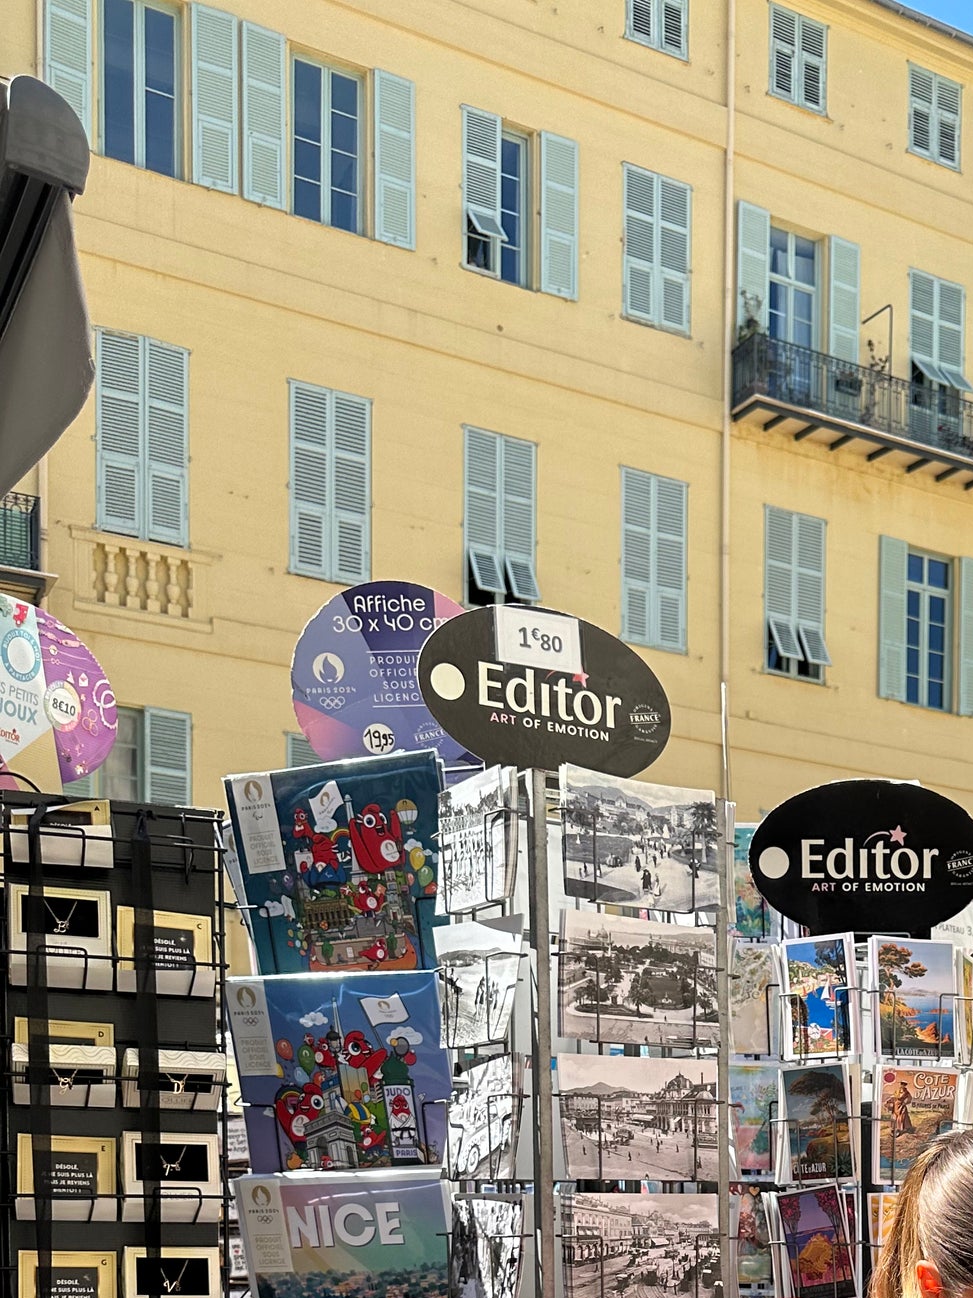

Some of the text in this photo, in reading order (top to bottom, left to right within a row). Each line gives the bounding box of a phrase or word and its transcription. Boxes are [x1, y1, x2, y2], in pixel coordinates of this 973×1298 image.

[354, 594, 426, 613] Affiche
[333, 615, 363, 633] 30
[368, 619, 380, 632] x
[383, 613, 414, 632] 40
[518, 627, 563, 653] 1€80
[306, 687, 331, 695] PARIS
[383, 680, 415, 689] SOUS
[9, 685, 39, 706] PETITS
[373, 693, 420, 703] LICENC
[477, 660, 621, 729] Editor
[52, 698, 76, 716] 8€10
[490, 712, 609, 742] ART OF EMOTION
[630, 714, 659, 723] FRANCE
[801, 837, 939, 879] Editor
[812, 882, 926, 892] ART OF EMOTION
[385, 1088, 411, 1096] JUDO
[394, 1150, 418, 1158] PARIS
[286, 1202, 405, 1248] NICE
